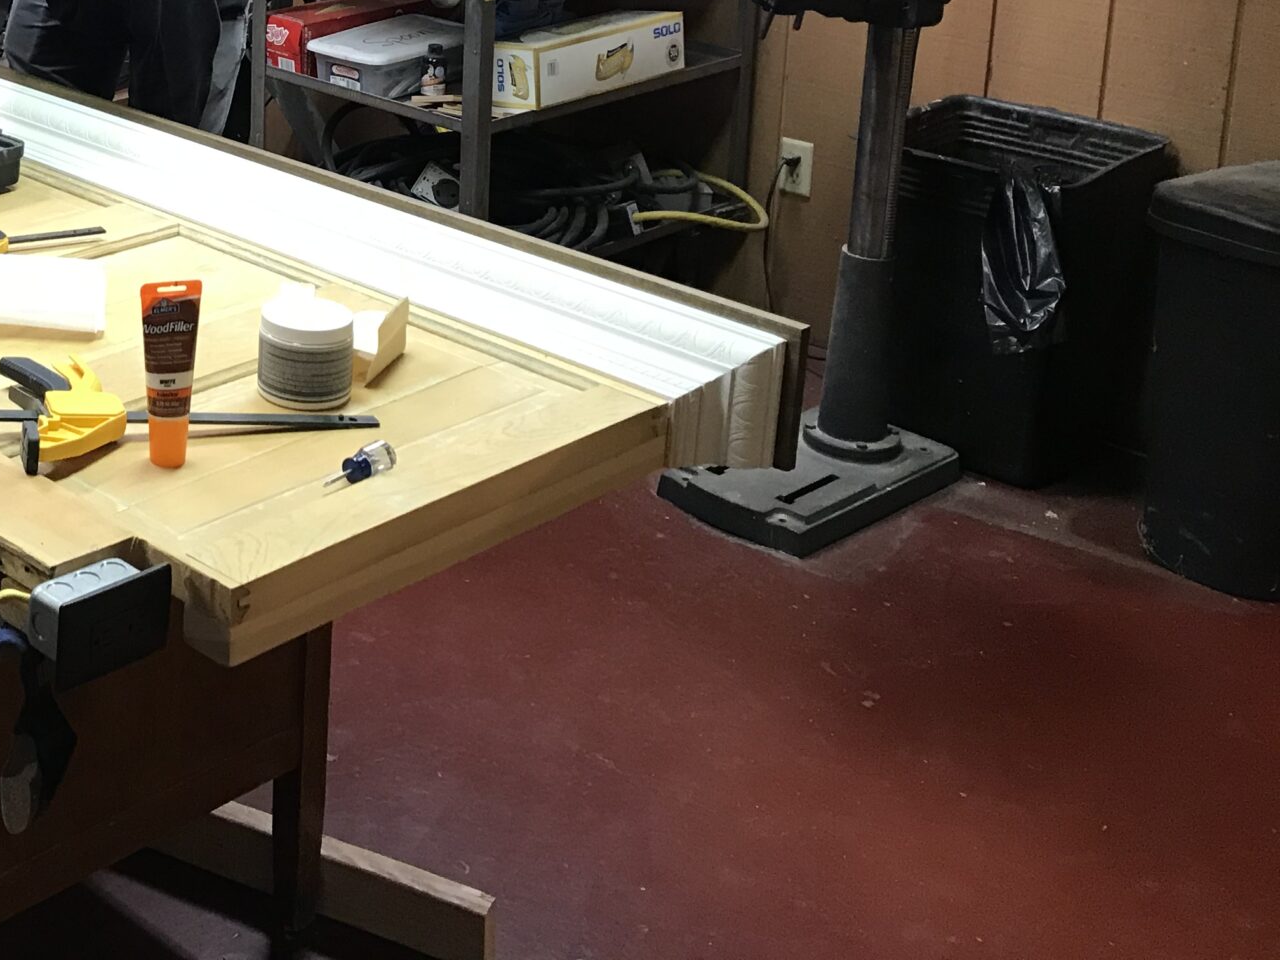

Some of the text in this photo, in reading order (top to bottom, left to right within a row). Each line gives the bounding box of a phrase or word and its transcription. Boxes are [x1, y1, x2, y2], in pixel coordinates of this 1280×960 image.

[266, 24, 289, 46] Joy
[653, 22, 681, 39] SOLO
[496, 58, 506, 93] SOLO
